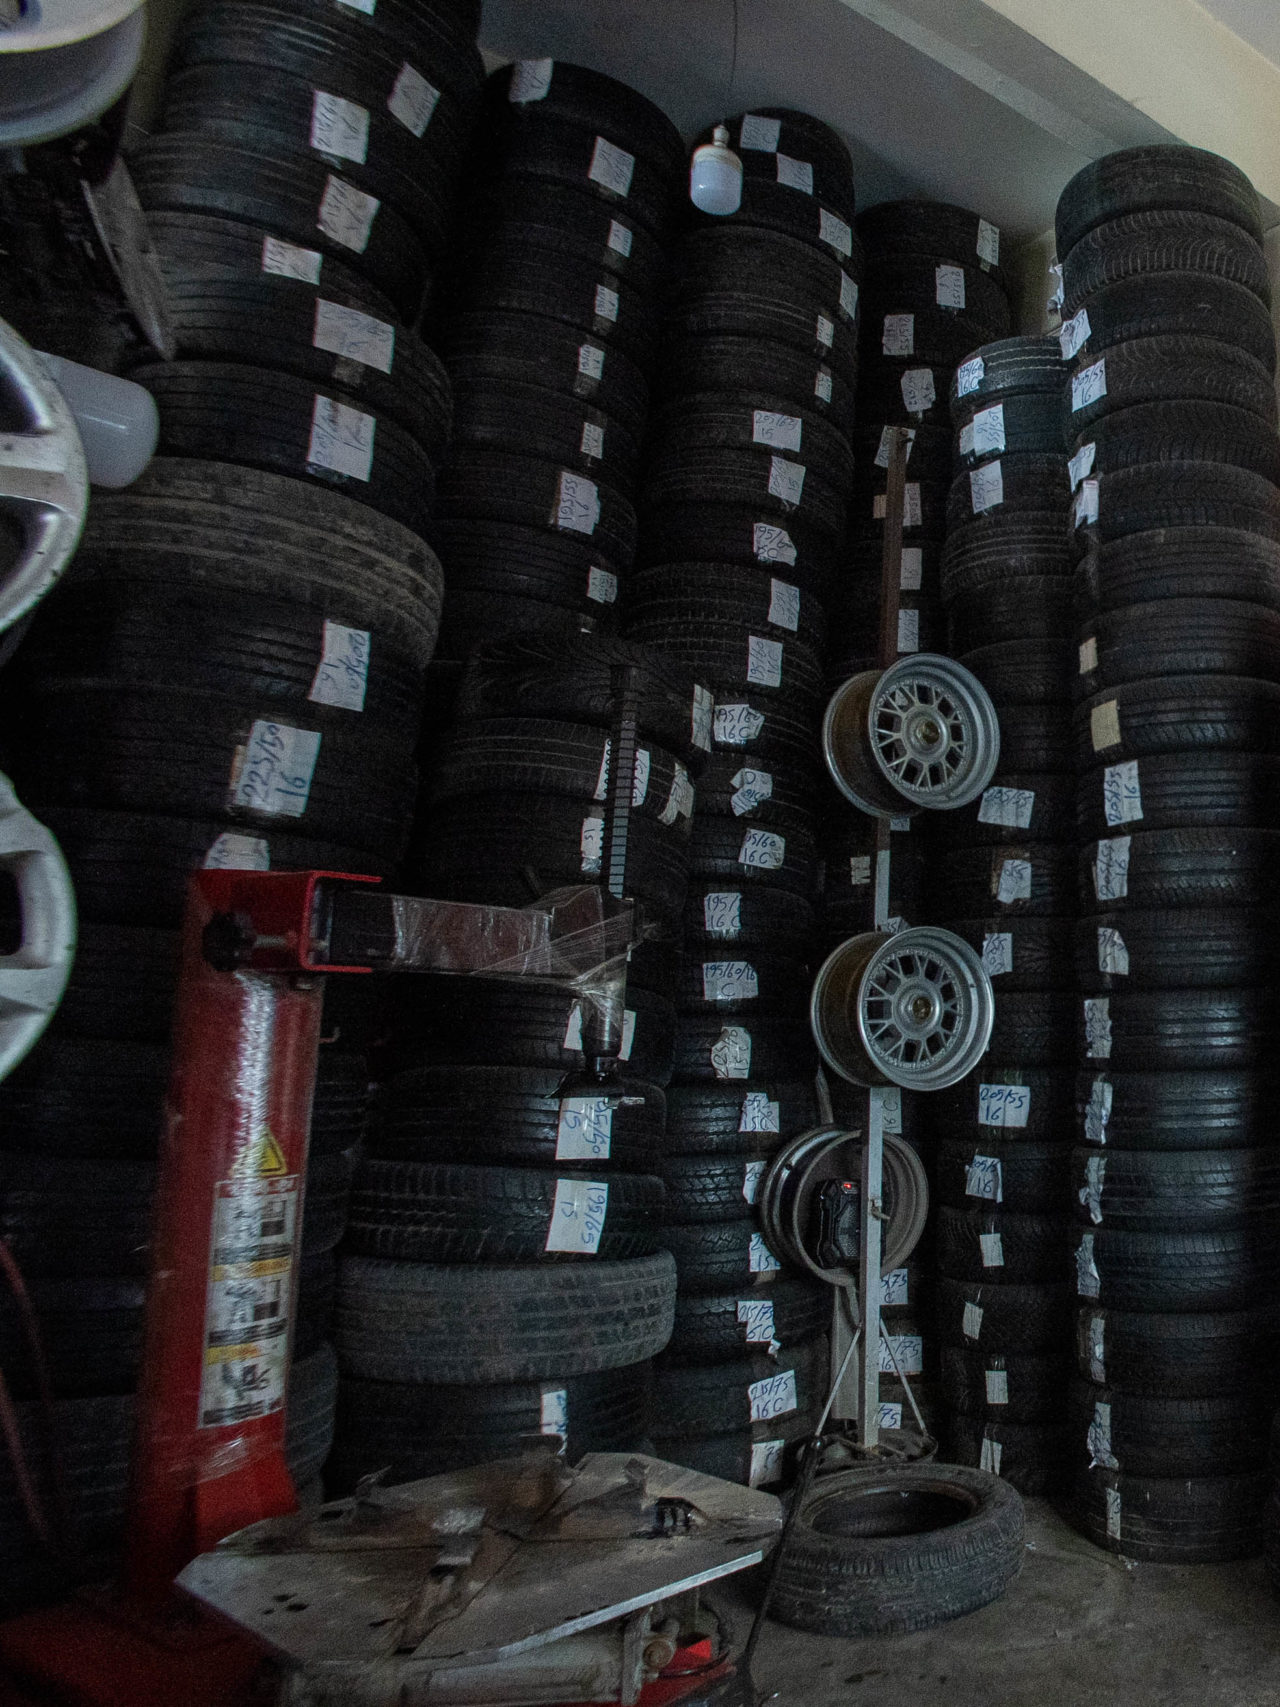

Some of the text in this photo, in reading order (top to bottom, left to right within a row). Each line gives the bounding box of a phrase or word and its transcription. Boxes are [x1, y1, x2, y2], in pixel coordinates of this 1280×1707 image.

[241, 722, 285, 801] 225/50
[276, 773, 308, 800] 16
[979, 1086, 1027, 1109] 205/55
[985, 1107, 1002, 1122] 16
[749, 1376, 789, 1401] 215/75
[755, 1398, 784, 1418] 16C
